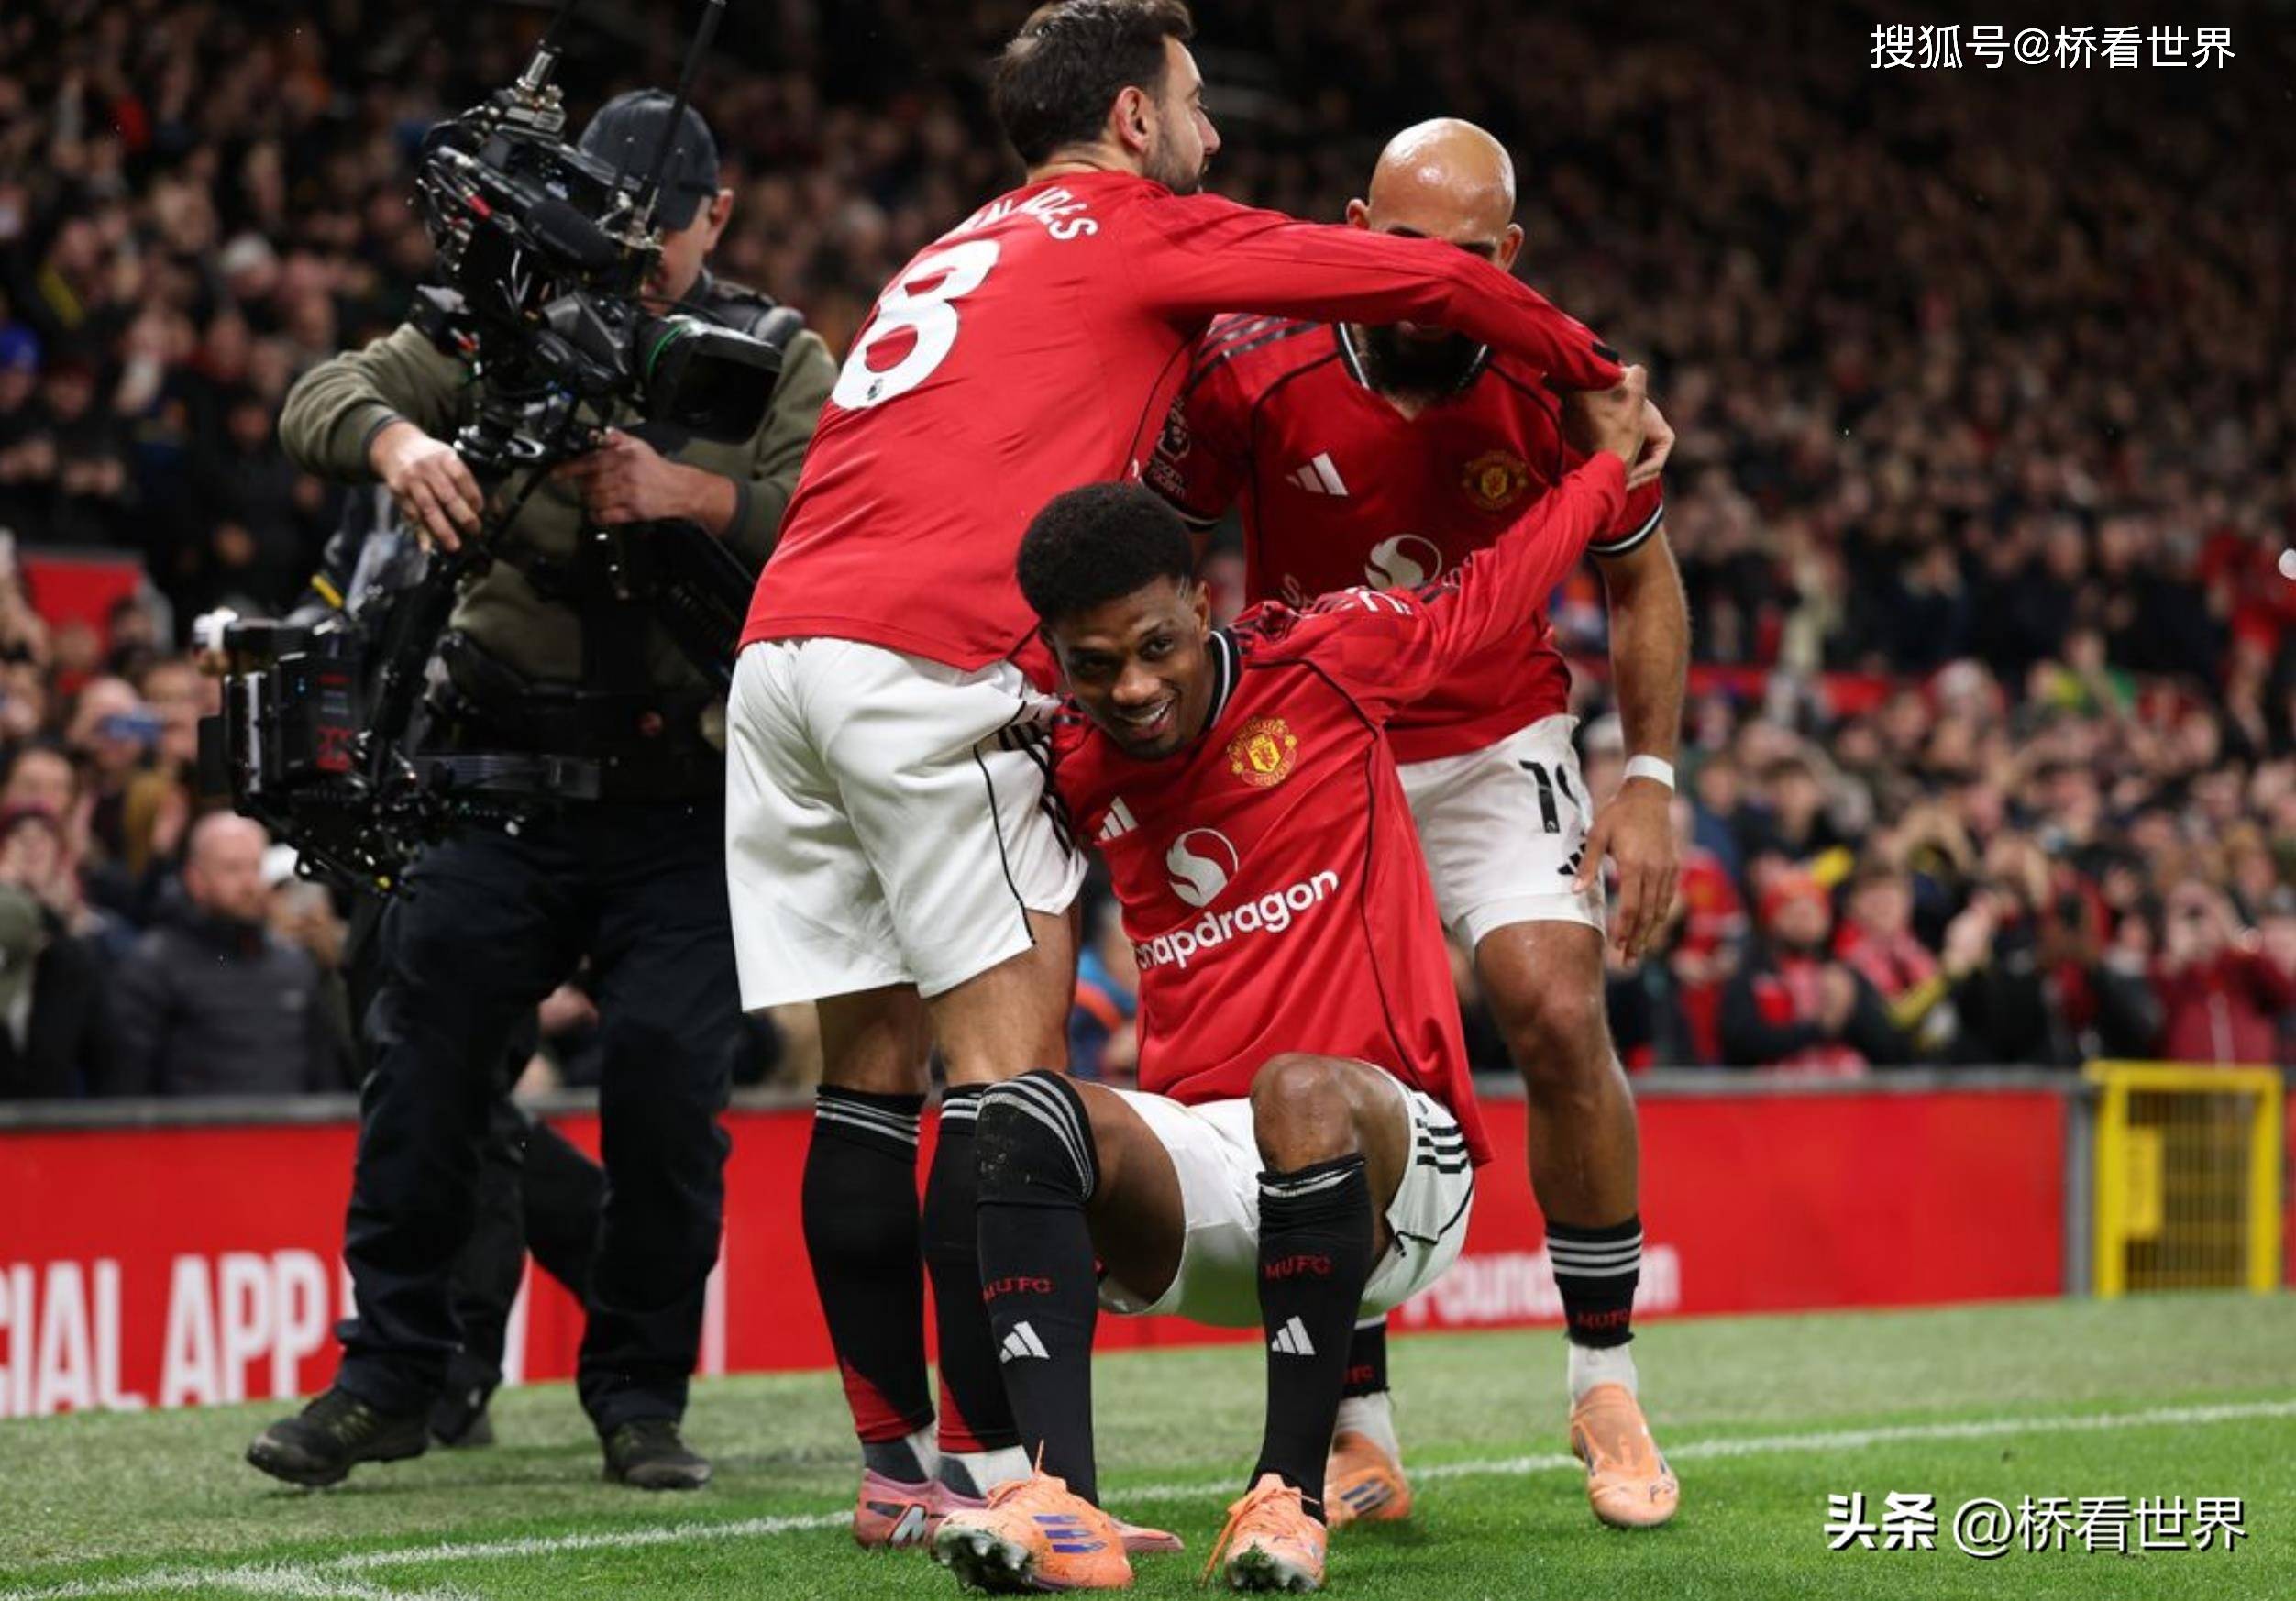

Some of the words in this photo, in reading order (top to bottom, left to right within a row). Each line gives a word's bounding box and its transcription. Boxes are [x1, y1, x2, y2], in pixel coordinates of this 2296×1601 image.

[831, 239, 1001, 410] 8
[982, 1275, 1052, 1301] MUFC
[1264, 1254, 1333, 1280] MUFC
[158, 1249, 328, 1410] APP
